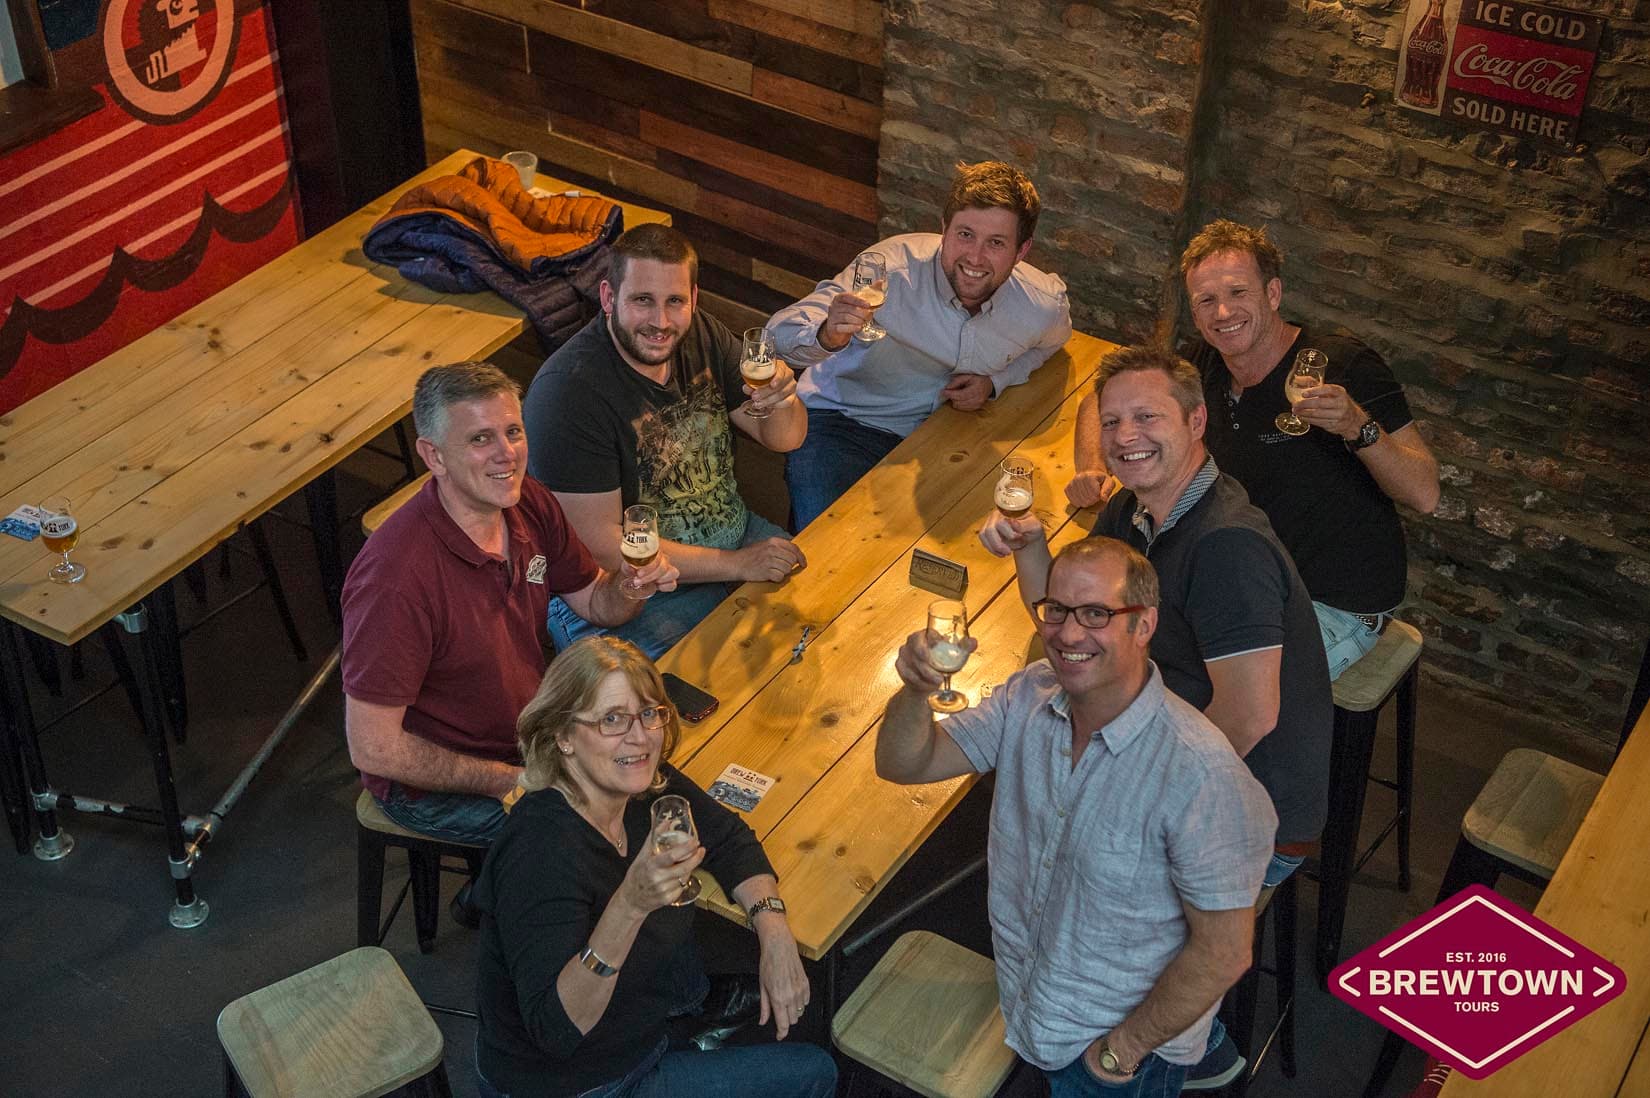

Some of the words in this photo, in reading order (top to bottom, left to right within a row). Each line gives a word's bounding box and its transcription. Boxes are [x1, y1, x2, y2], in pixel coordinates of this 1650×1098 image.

[1475, 1, 1514, 27] ICE
[1520, 11, 1586, 41] COLD
[1453, 43, 1585, 100] Coca-Cola
[1452, 97, 1506, 125] SOLD
[1510, 110, 1569, 140] HERE
